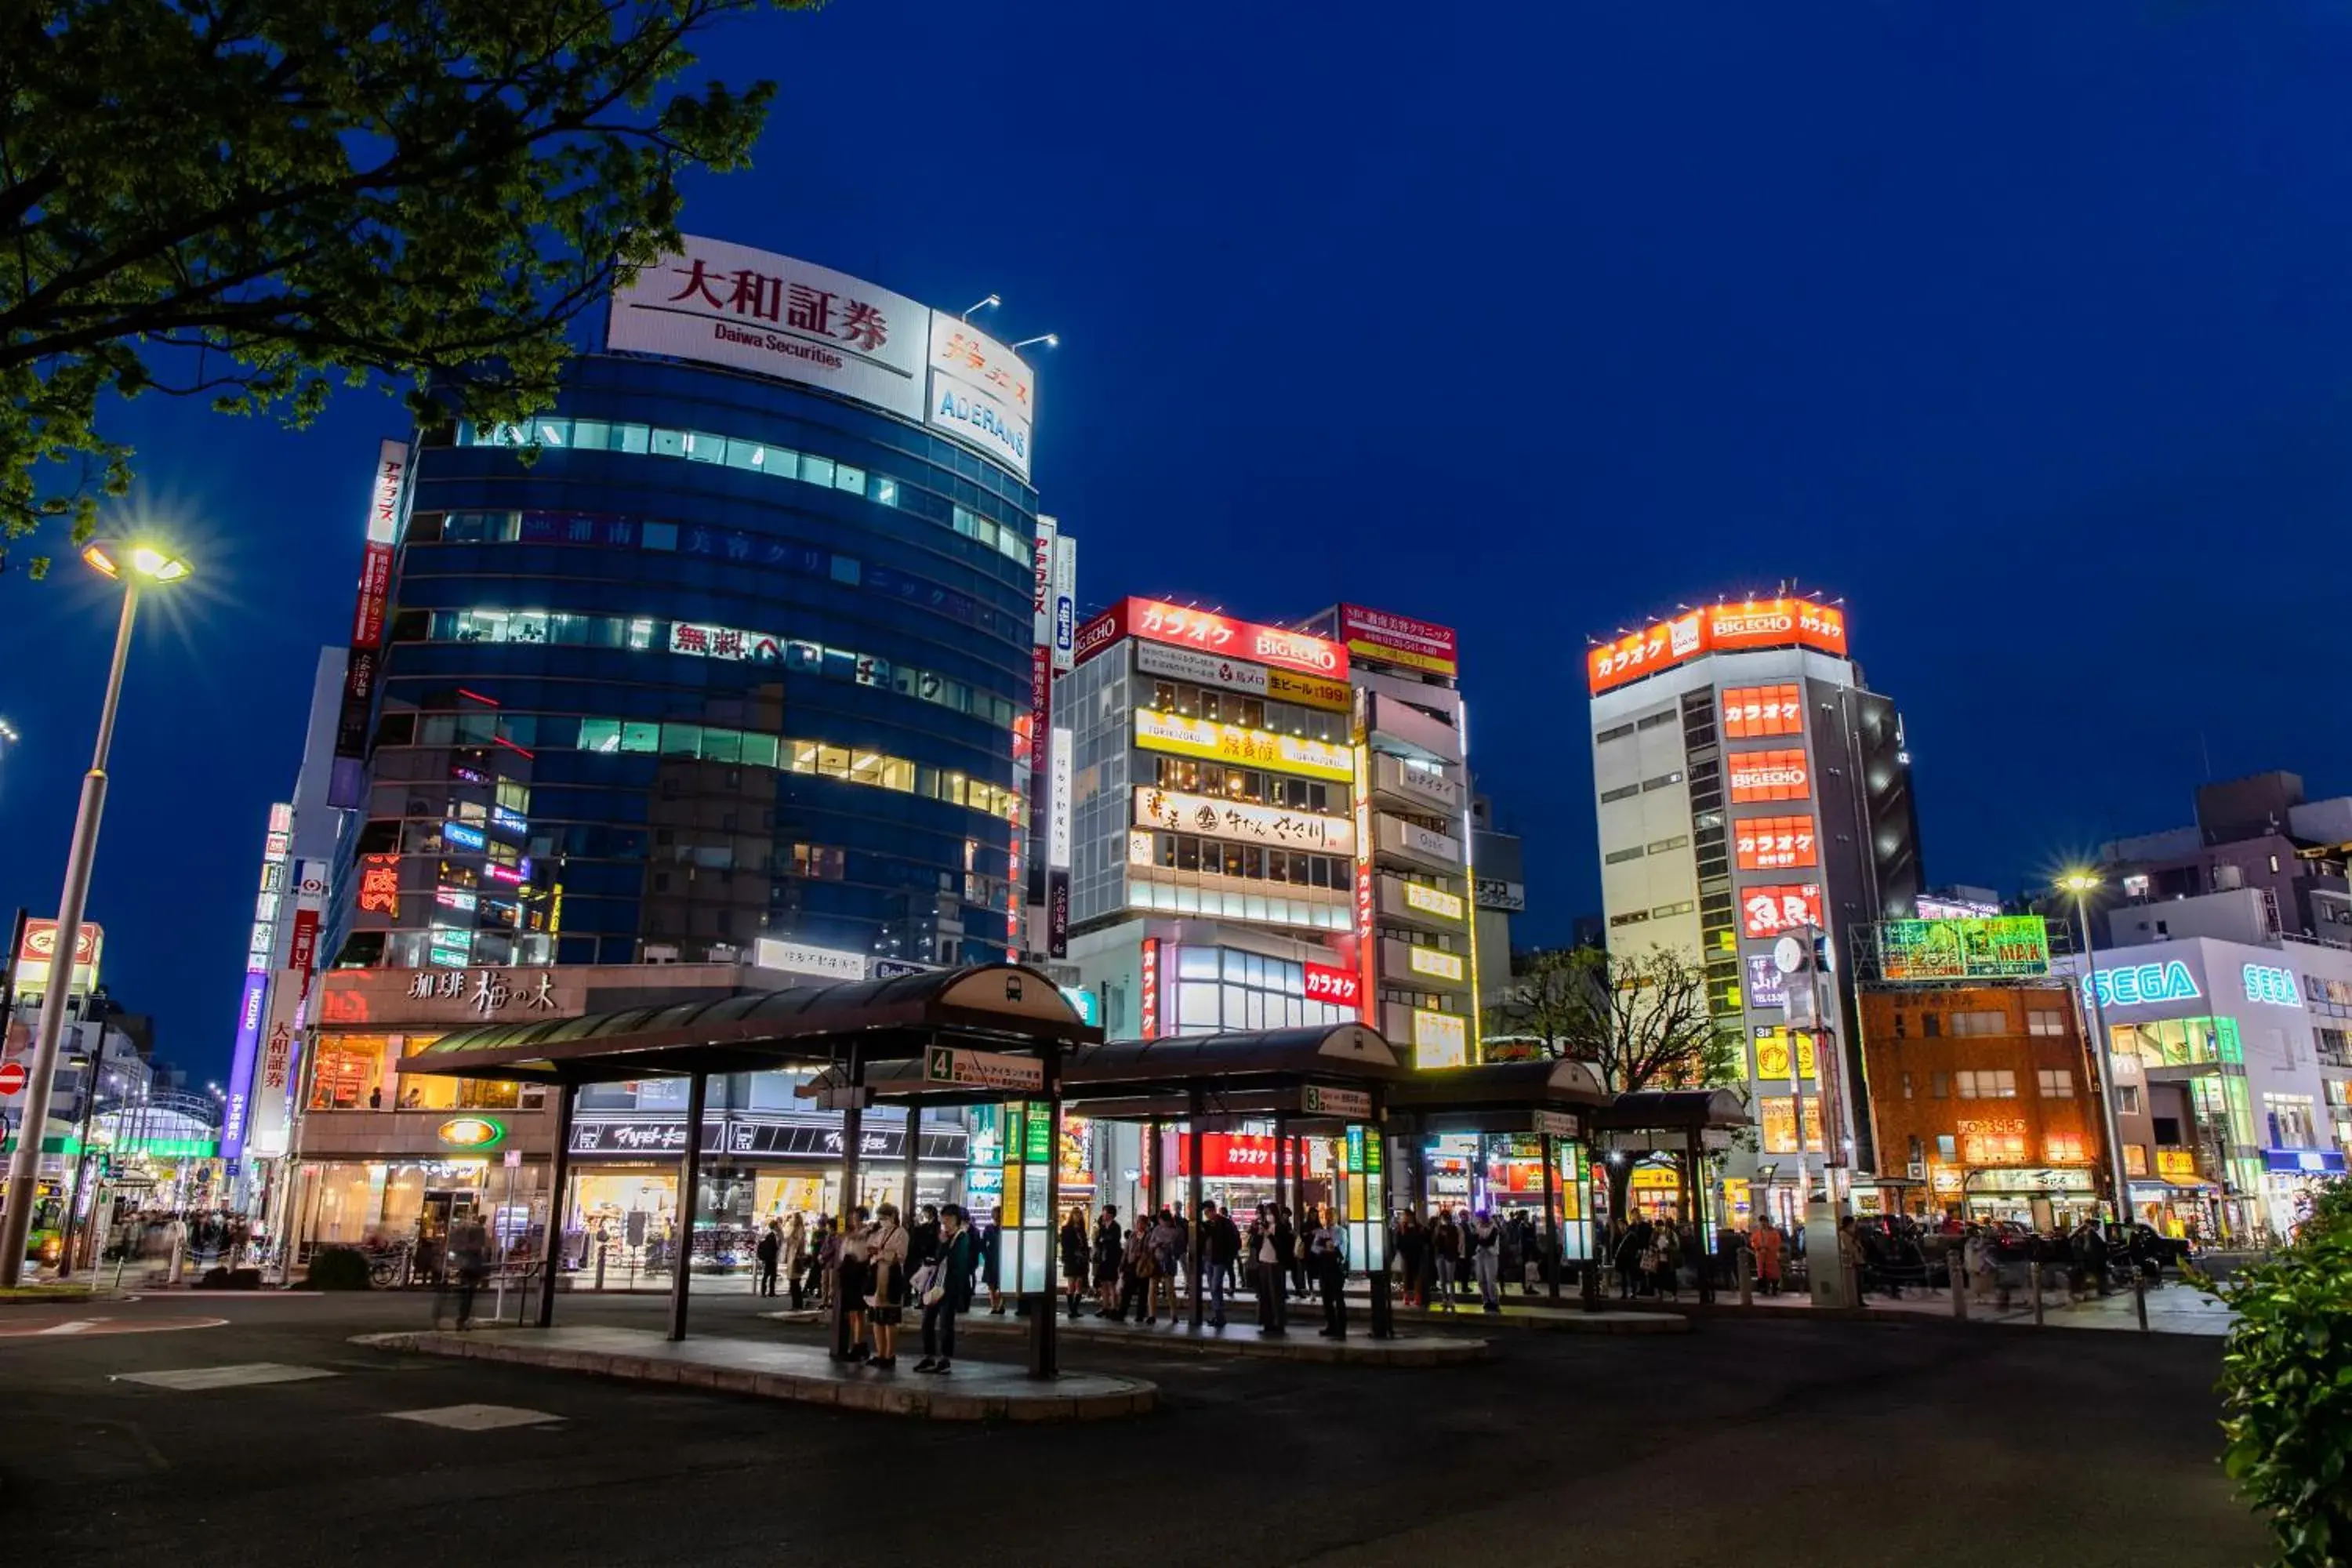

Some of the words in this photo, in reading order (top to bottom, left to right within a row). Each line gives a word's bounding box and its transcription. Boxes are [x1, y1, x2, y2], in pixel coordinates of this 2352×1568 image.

[668, 260, 887, 351] 大和証券
[714, 323, 764, 350] Daiwa
[766, 335, 843, 370] Securities
[939, 392, 1025, 459] ADERANS
[1058, 601, 1070, 646] Berlitz
[1086, 618, 1116, 645] ECHO
[1142, 607, 1234, 645] カラオケ
[1712, 620, 1744, 637] BIG
[1748, 616, 1791, 632] ECHO
[1800, 615, 1842, 637] カラオケ
[1256, 634, 1290, 658] BIG
[1290, 641, 1336, 670] ECHO
[1598, 639, 1665, 678] カラオケ
[1270, 676, 1312, 695] 生ビール
[1724, 702, 1799, 721] カラオケ
[1731, 774, 1761, 788] BIG
[1762, 770, 1806, 784] ECHO
[1737, 833, 1814, 852] カラオケ
[1358, 873, 1370, 938] カラオケ
[408, 971, 466, 999] 珈琲
[470, 970, 558, 1014] 梅の木
[1142, 950, 1155, 1031] カラオケ
[1307, 972, 1356, 999] カラオケ
[2082, 960, 2201, 1009] SEGA
[2244, 964, 2303, 1008] SEGA
[245, 988, 262, 1030] MIZUHO
[1756, 1028, 1772, 1038] 3F
[266, 1021, 291, 1088] 大和証券
[934, 1051, 948, 1077] 4
[1308, 1089, 1316, 1109] 3
[1229, 1147, 1269, 1164] カラオケ
